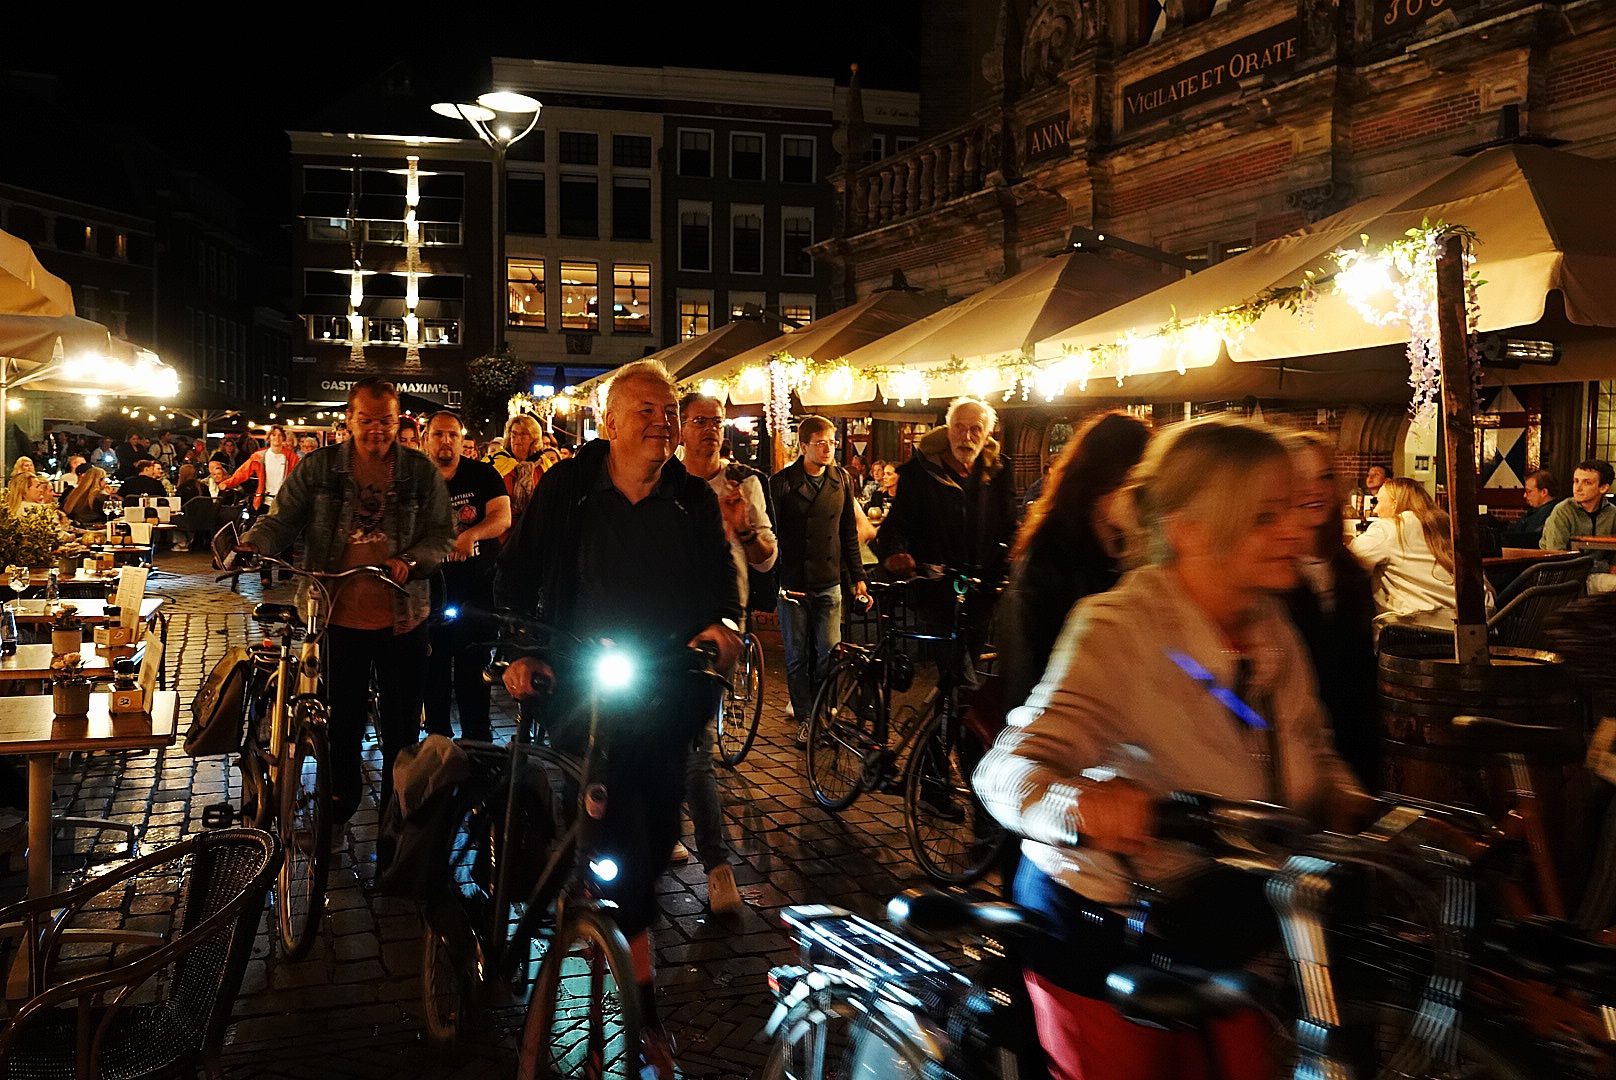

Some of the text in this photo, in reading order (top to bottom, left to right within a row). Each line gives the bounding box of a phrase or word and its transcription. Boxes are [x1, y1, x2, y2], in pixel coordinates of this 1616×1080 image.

[1126, 37, 1297, 115] VIGILATE ET ORATE
[396, 382, 449, 393] MAXIM'S
